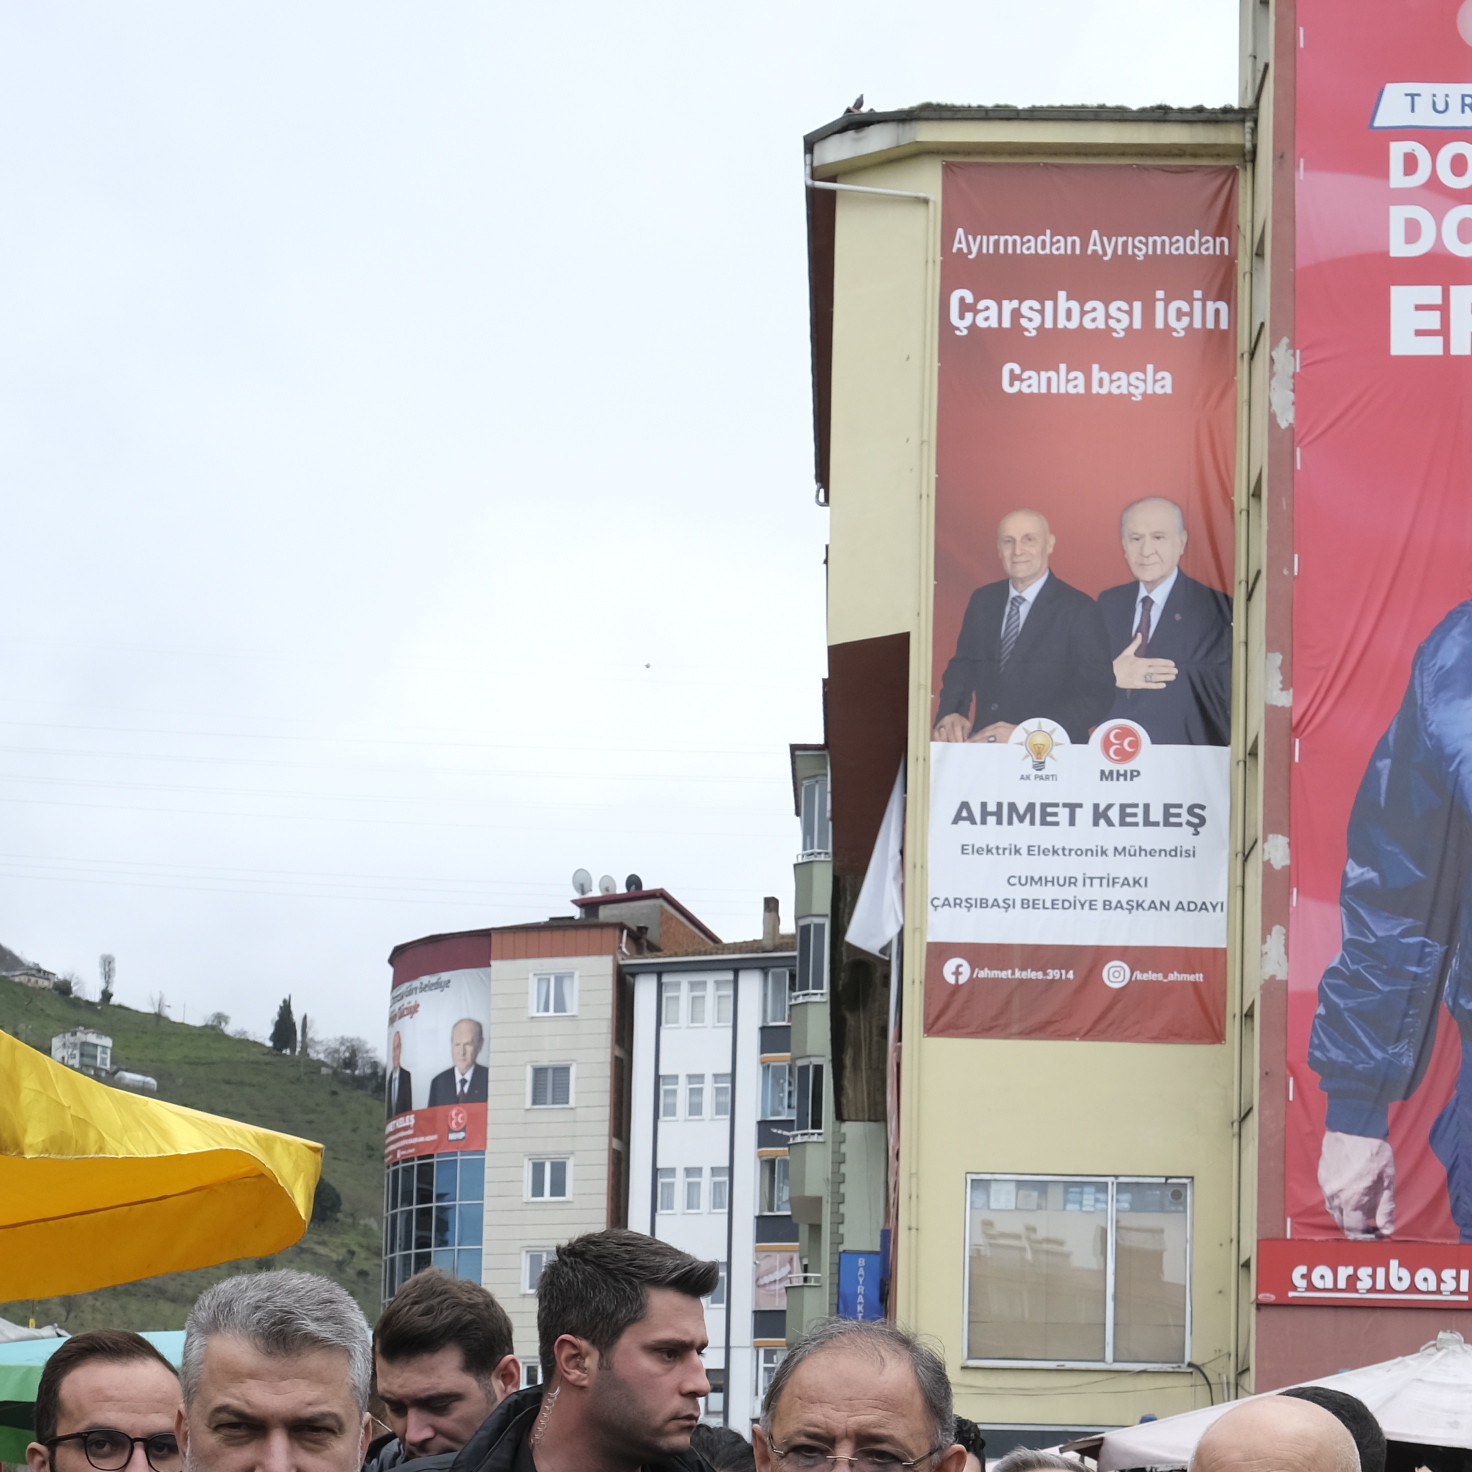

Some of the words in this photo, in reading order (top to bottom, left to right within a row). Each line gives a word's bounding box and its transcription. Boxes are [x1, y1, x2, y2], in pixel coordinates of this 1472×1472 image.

[952, 227, 1080, 260] Ayırmadan
[1087, 229, 1230, 261] Ayrışmadan
[949, 288, 1143, 338] Çarşıbaşı
[1154, 289, 1229, 338] için
[1001, 362, 1085, 394] Canla
[1091, 363, 1173, 401] başla
[1019, 773, 1032, 782] AK
[1099, 769, 1141, 783] MHP
[951, 801, 1084, 827] AHMET
[1092, 802, 1208, 837] KELEŞ
[960, 843, 1023, 857] Elektrik
[1026, 844, 1109, 858] Elektronik
[1113, 845, 1196, 859] Mühendisi
[1006, 874, 1078, 888] CUMHUR
[1082, 873, 1149, 889] İTTİFAKI
[930, 896, 1016, 913] ÇARŞIBAŞI
[1020, 895, 1099, 911] BELEDİYE
[1102, 899, 1171, 915] BAŞKAN
[1174, 900, 1224, 914] ADAYI
[1291, 1258, 1470, 1296] çarşıbaşı
